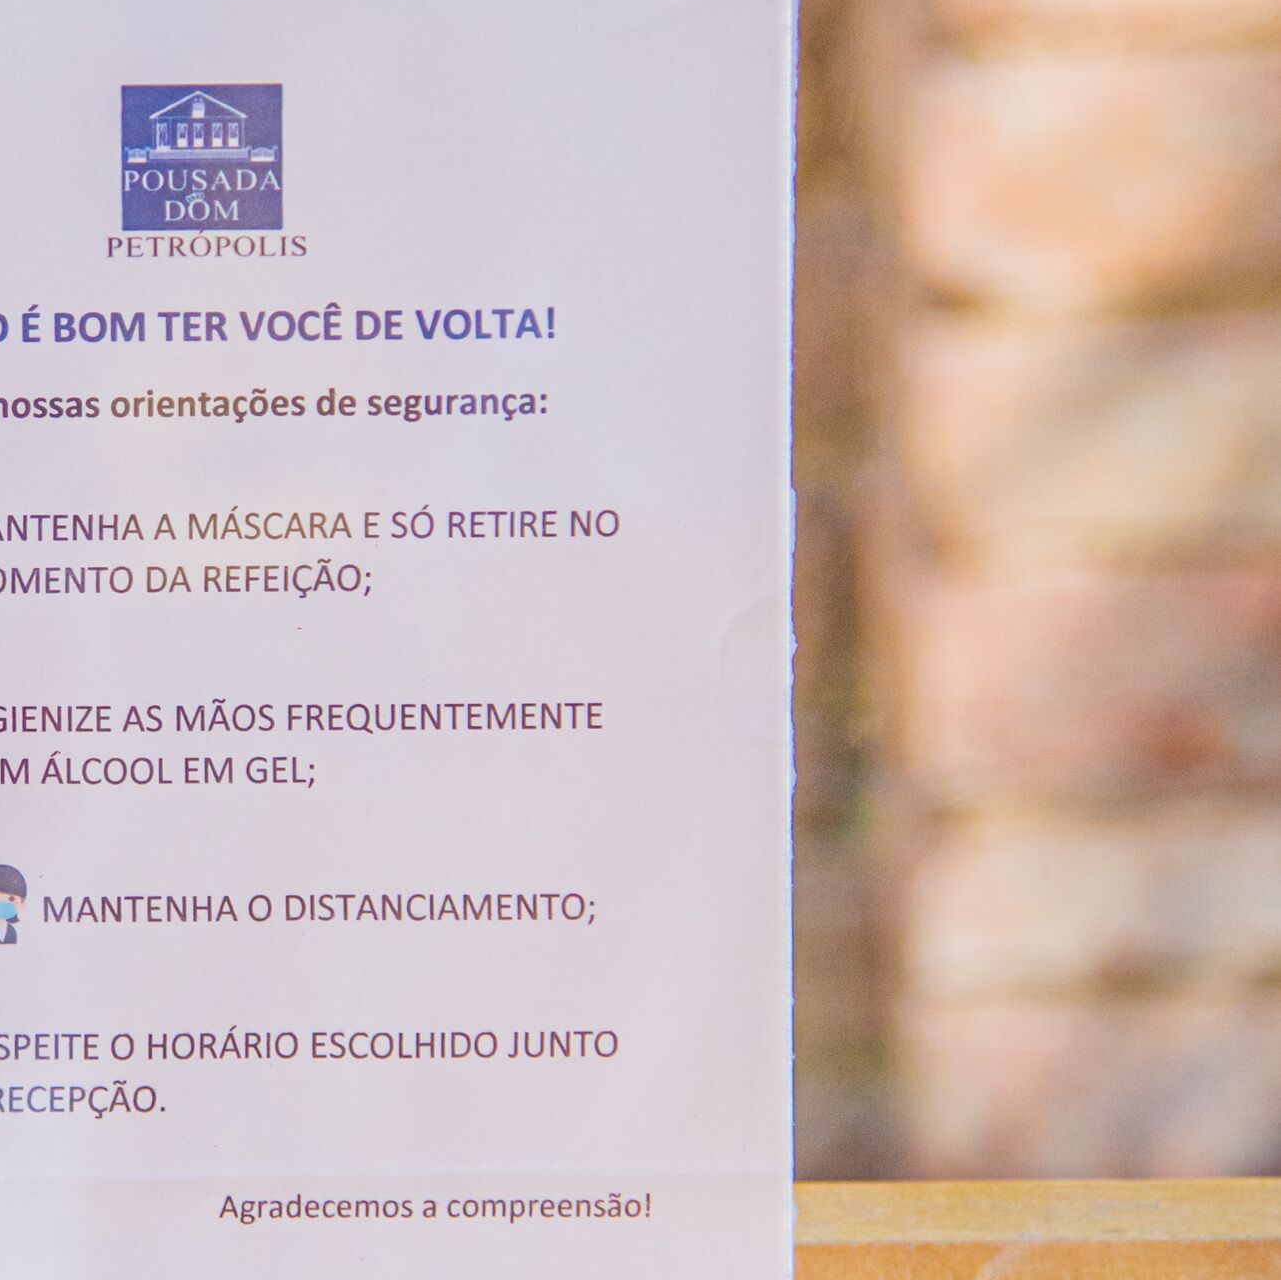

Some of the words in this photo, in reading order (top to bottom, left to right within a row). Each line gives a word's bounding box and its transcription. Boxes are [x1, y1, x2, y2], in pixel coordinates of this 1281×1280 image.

[124, 169, 282, 191] POUSADA
[164, 200, 239, 221] DOM
[107, 229, 307, 257] PETRÓPOLIS
[21, 304, 41, 343] É
[54, 311, 146, 342] BOM
[158, 311, 228, 342] TER
[239, 302, 342, 341] VOCÊ
[355, 310, 404, 341] DE
[415, 306, 556, 339] VOLTA!
[111, 388, 306, 423] orientações
[317, 389, 357, 416] de
[367, 392, 548, 422] segurança:
[154, 513, 177, 541] A
[188, 506, 352, 540] MÁSCARA
[364, 512, 380, 538] E
[391, 505, 434, 539] SÓ
[448, 511, 558, 538] RETIRE
[571, 510, 620, 538] NO
[146, 566, 191, 593] DA
[204, 558, 372, 598] REFEIÇÃO;
[123, 705, 163, 732] AS
[176, 698, 275, 732] MÃOS
[288, 702, 603, 734] FREQUENTEMENTE
[41, 751, 172, 785] ÁLCOOL
[185, 757, 234, 784] EM
[245, 757, 316, 788] GEL;
[43, 895, 238, 923] MANTENHA
[248, 895, 273, 923] O
[285, 893, 596, 925] DISTANCIAMENTO;
[111, 1033, 135, 1060] O
[148, 1025, 299, 1060] HORÁRIO
[312, 1032, 498, 1059] ESCOLHIDO
[508, 1030, 619, 1058] JUNTO
[220, 1194, 413, 1224] Agradecemos
[422, 1200, 437, 1218] a
[447, 1193, 651, 1224] compreensão!
